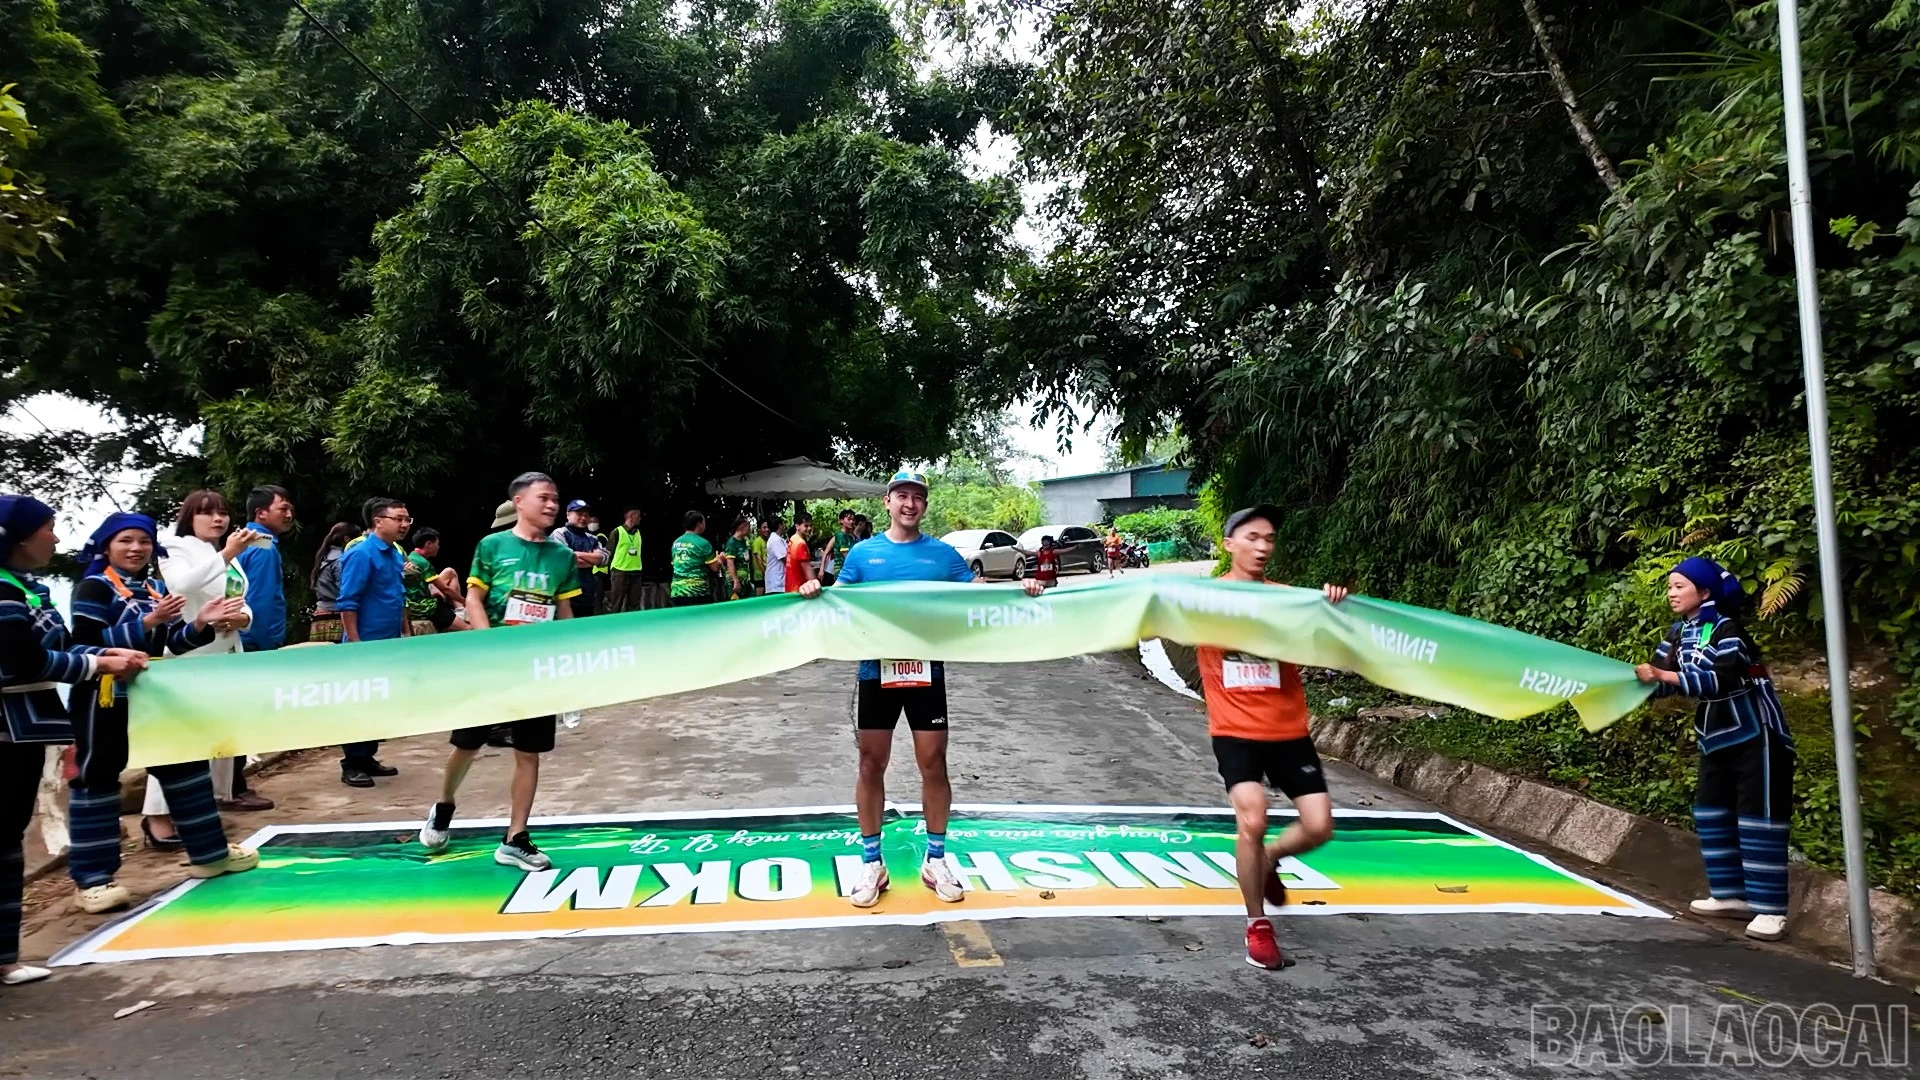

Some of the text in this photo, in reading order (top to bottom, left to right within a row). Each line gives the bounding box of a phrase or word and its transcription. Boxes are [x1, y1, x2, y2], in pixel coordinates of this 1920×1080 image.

[892, 661, 923, 675] 10040
[681, 833, 719, 853] Y
[724, 829, 790, 847] mây
